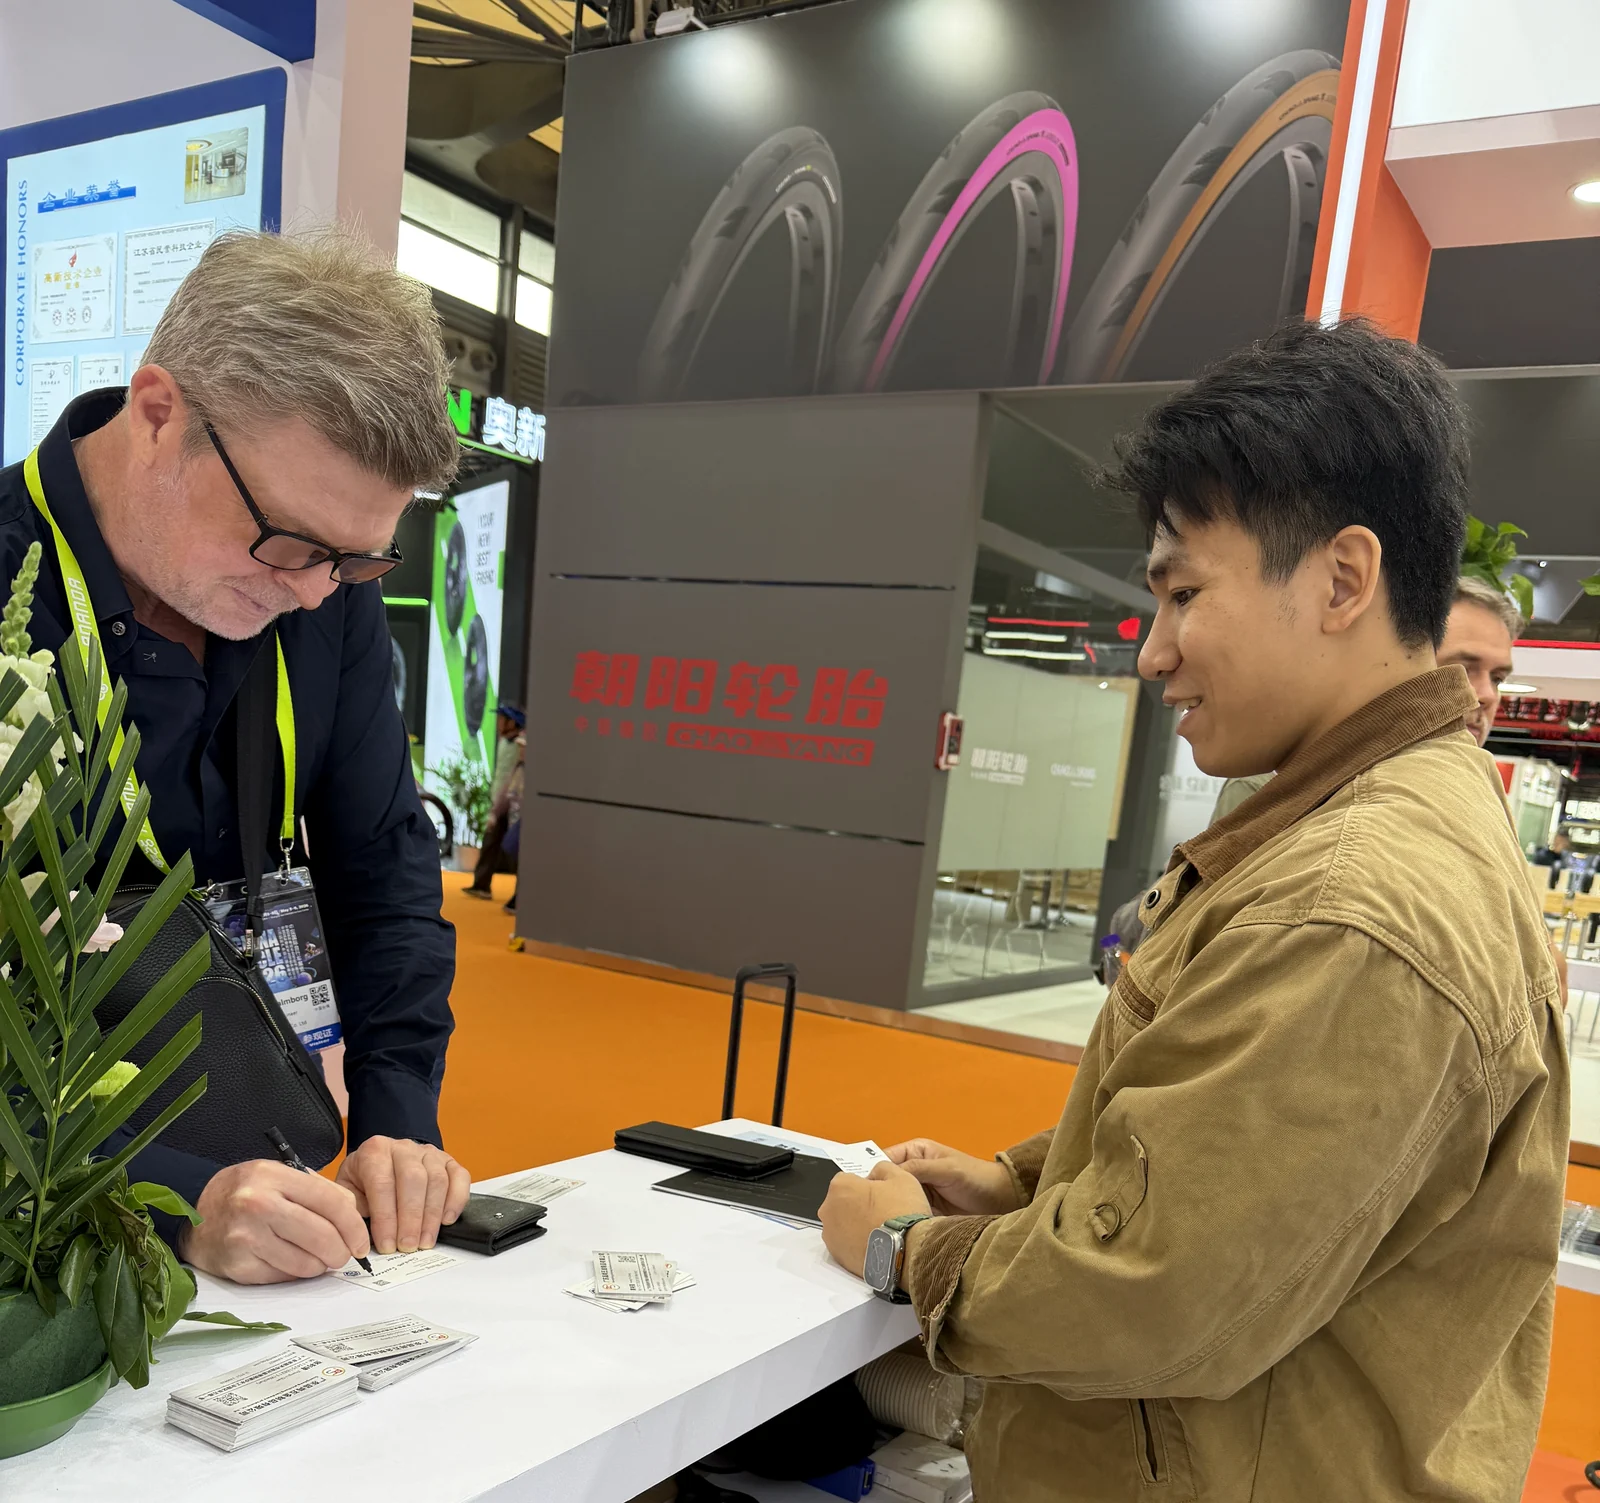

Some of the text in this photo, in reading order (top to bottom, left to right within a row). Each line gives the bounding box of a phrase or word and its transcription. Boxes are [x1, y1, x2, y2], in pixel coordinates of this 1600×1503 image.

[42, 179, 122, 209] 企业荣誉
[15, 180, 28, 386] CORPORATE HONORS
[482, 396, 546, 462] 奥新
[67, 577, 93, 646] ANANDA
[569, 649, 889, 729] 朝阳轮胎
